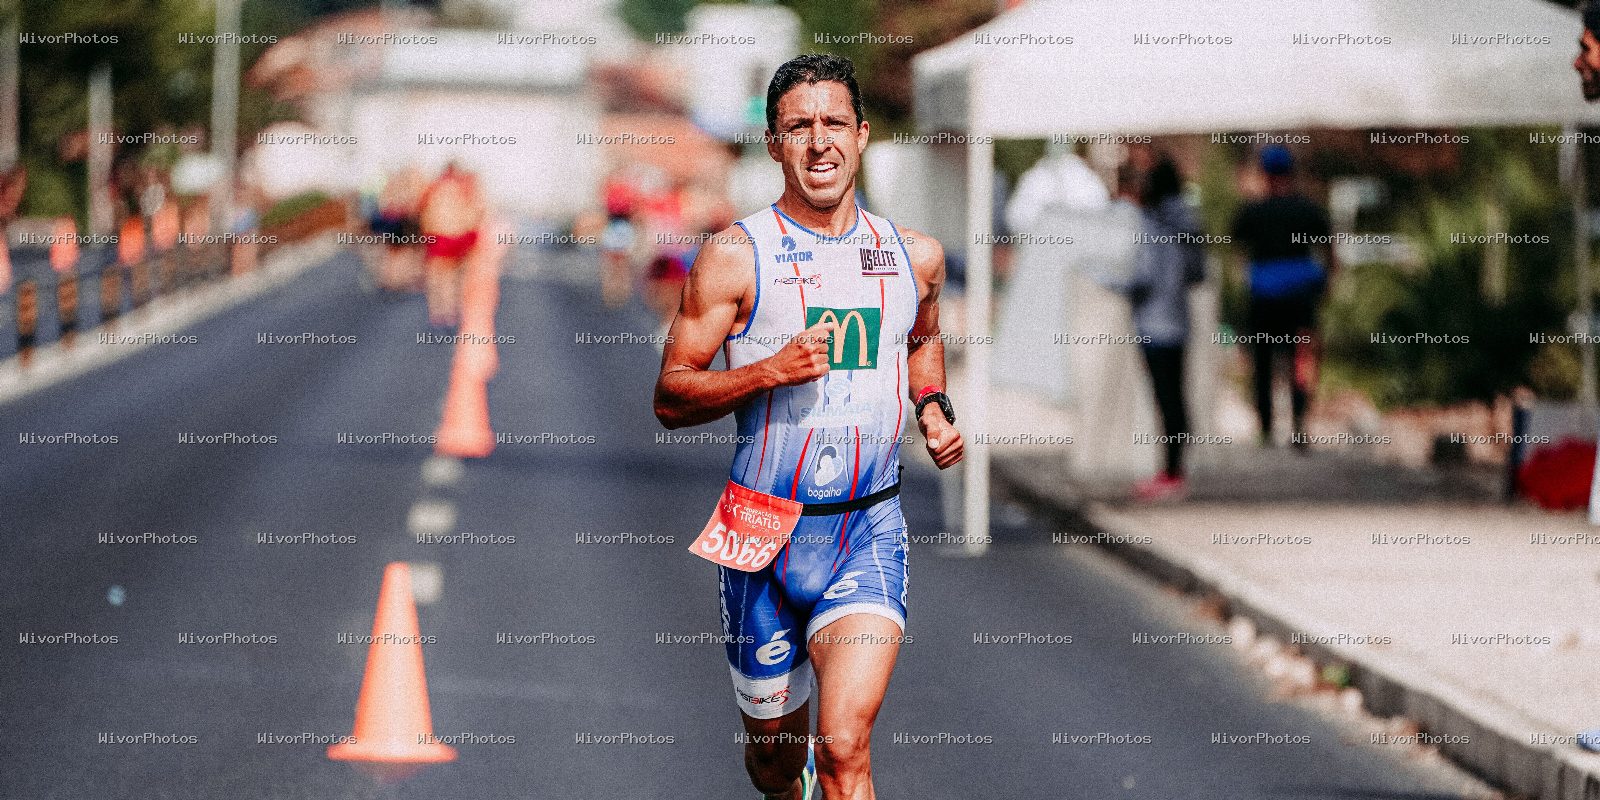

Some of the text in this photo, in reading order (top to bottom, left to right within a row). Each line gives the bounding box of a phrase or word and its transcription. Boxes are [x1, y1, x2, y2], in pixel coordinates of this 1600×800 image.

[775, 251, 813, 263] VIATOR
[807, 487, 842, 500] bogalho
[740, 511, 781, 531] TRIATLO
[701, 521, 777, 568] 5066
